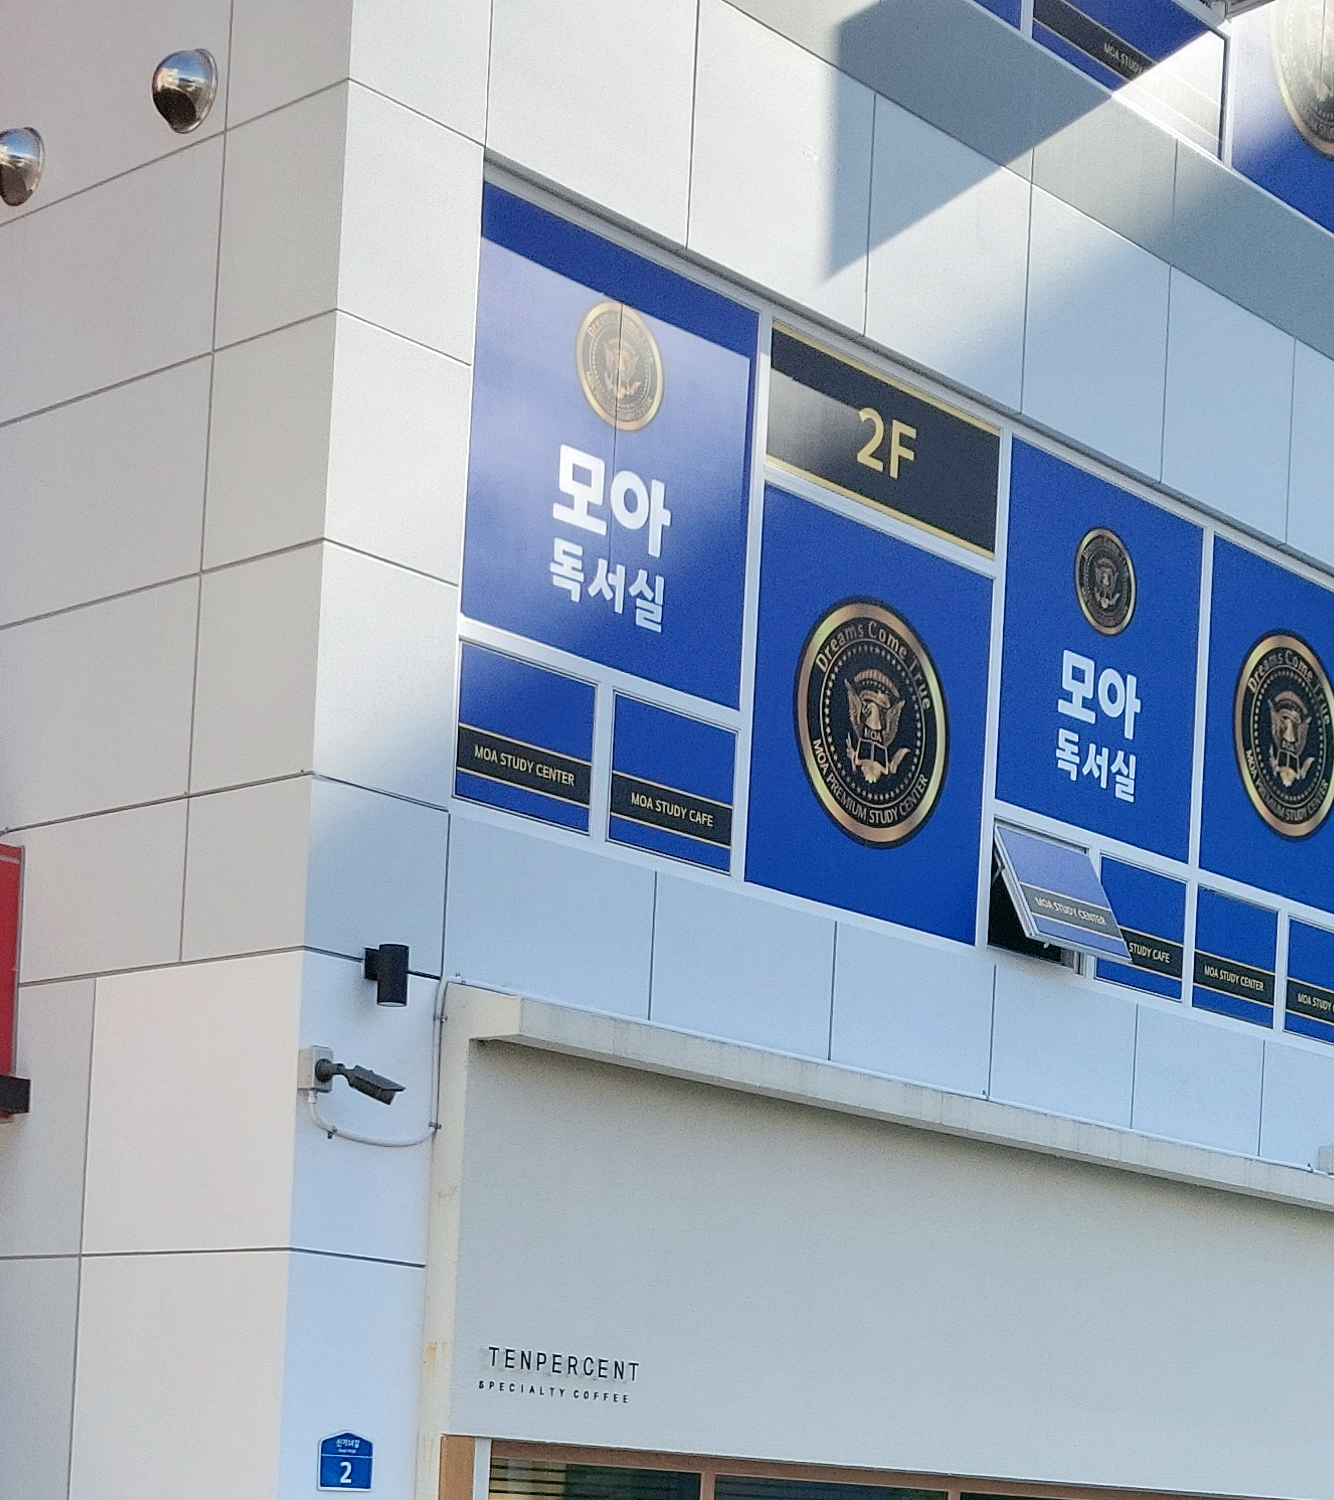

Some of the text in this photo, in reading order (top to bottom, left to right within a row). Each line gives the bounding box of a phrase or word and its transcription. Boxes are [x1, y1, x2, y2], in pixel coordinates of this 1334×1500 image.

[856, 406, 917, 479] 2F
[553, 444, 671, 558] 모아
[550, 538, 665, 633] 독서실
[816, 621, 931, 710] Dreams Come True
[1058, 650, 1141, 740] 모아
[864, 727, 882, 743] MOA
[474, 745, 575, 787] MOA STUDY CENTER
[813, 739, 929, 825] MOA PREMIUM STUDY CENTER
[1056, 728, 1137, 803] 독서실
[631, 792, 714, 828] MOA STUDY CAFE
[1053, 902, 1078, 918] STUDY
[1077, 908, 1107, 926] CENTER
[1128, 942, 1171, 964] STUDY CAFE
[1204, 964, 1264, 992] MOA STUDY CENTER
[1312, 998, 1333, 1012] STUDY
[489, 1346, 640, 1382] TENPERCENT
[478, 1380, 629, 1404] SPECIALTY COFFEE
[340, 1461, 352, 1484] 2
